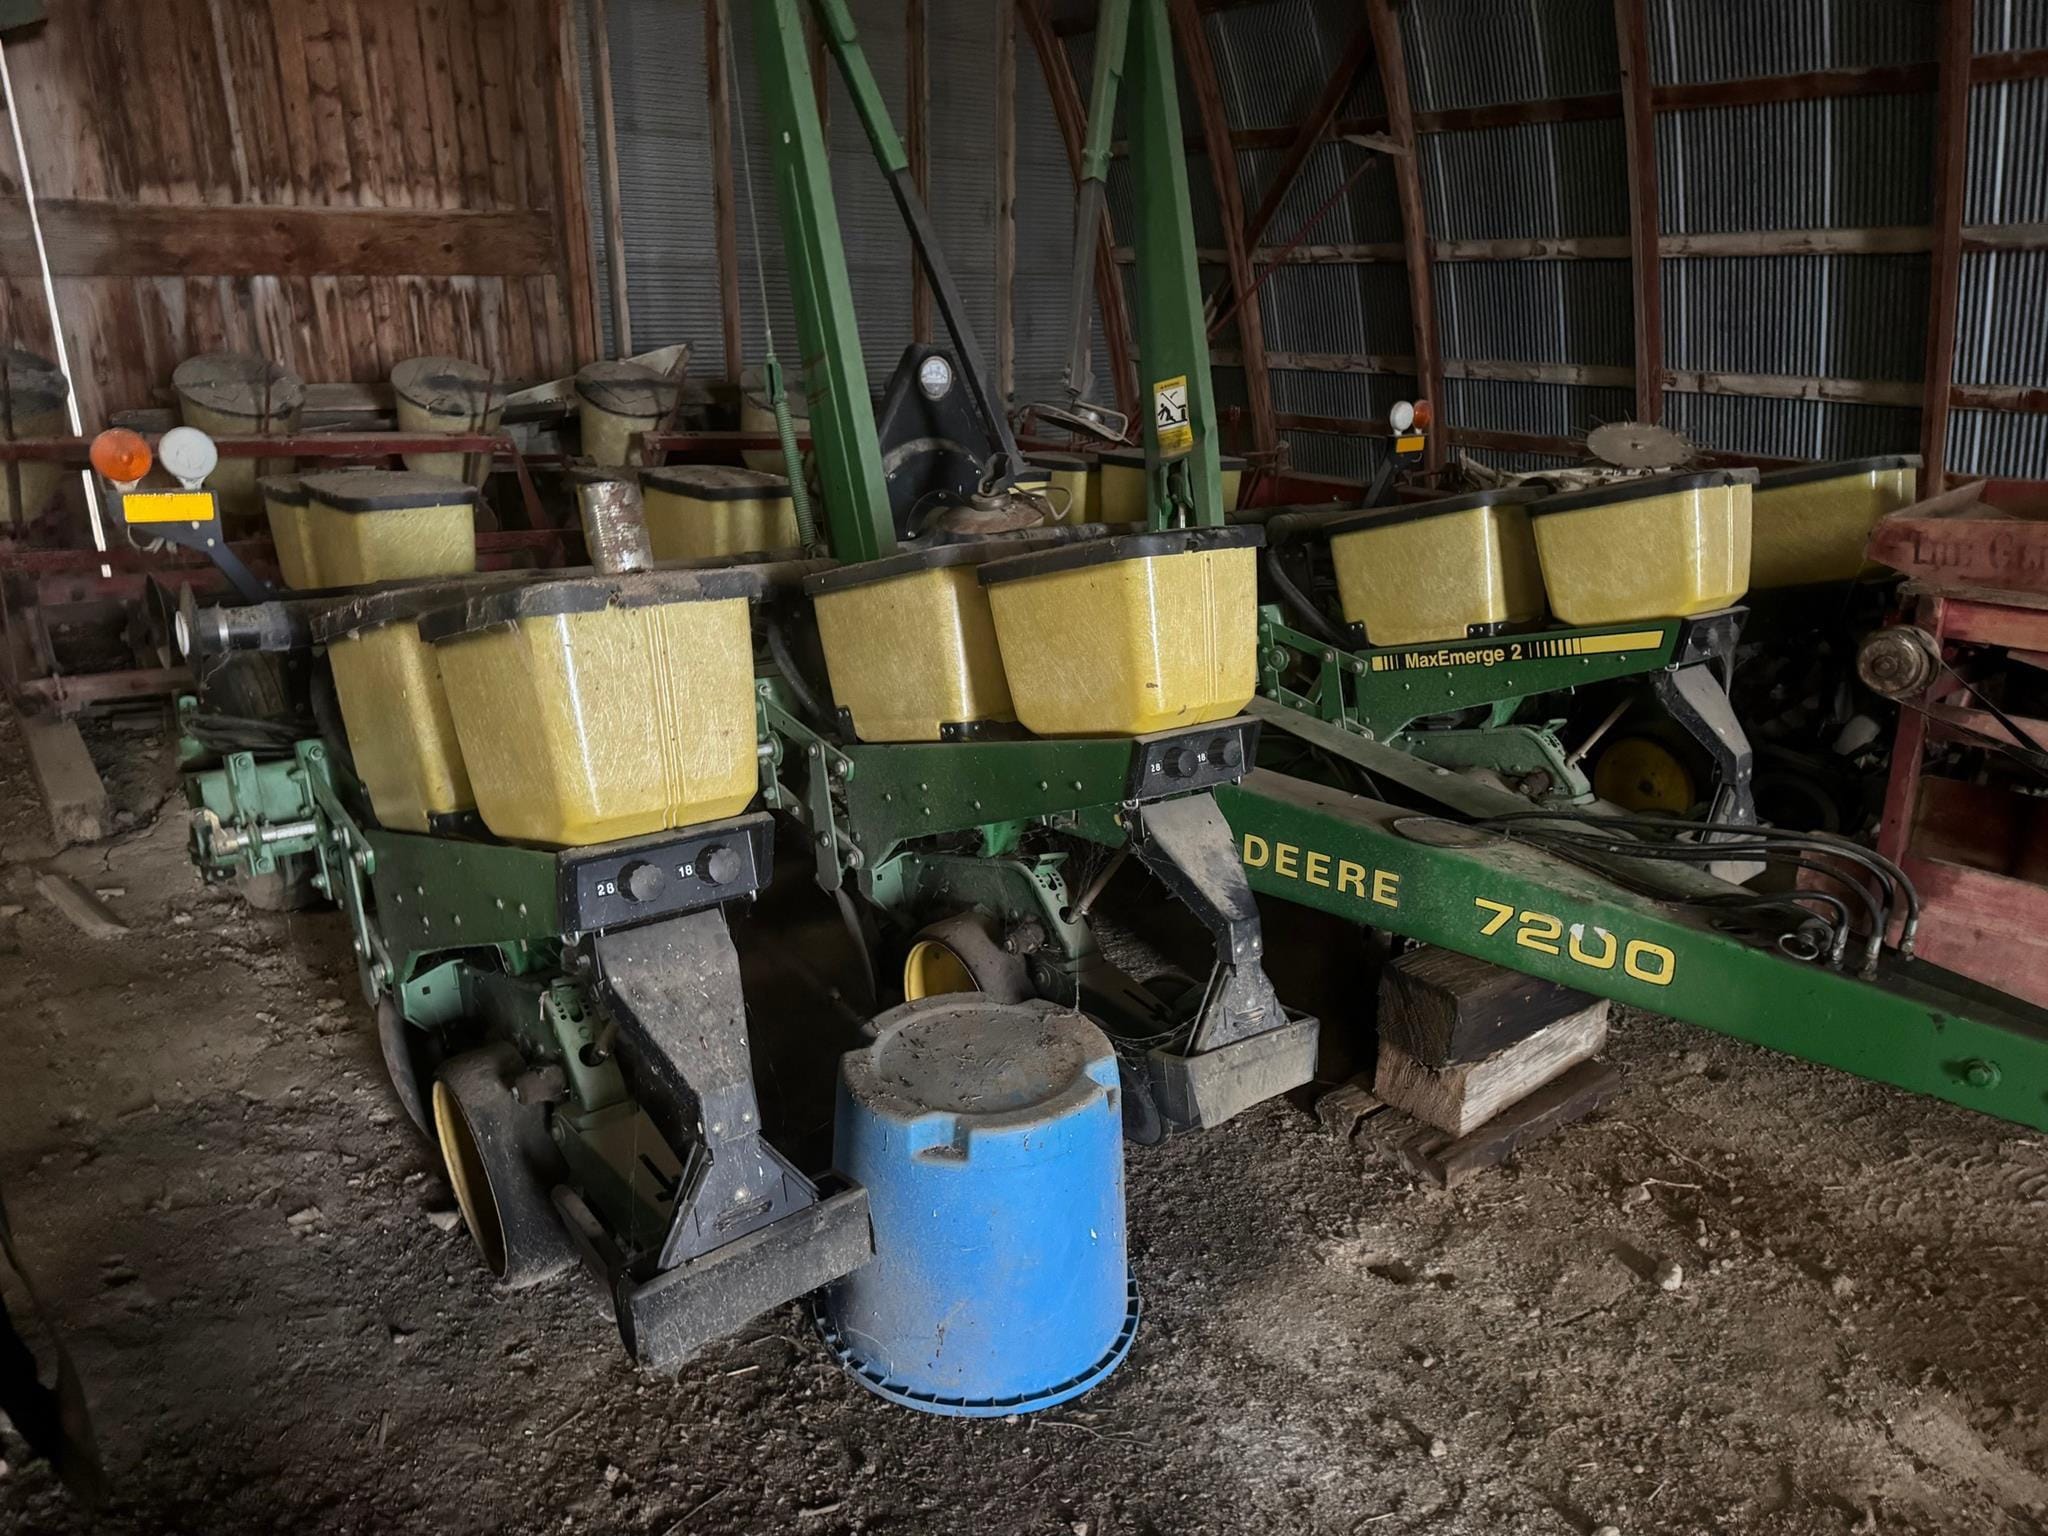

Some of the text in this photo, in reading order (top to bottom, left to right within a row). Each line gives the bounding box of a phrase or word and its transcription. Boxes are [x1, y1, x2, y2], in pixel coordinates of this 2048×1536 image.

[1405, 644, 1523, 669] MaxEmerge 2
[678, 864, 693, 878] 18
[1243, 832, 1401, 908] DEERE
[597, 882, 615, 896] 28
[1474, 896, 1677, 986] 7200
